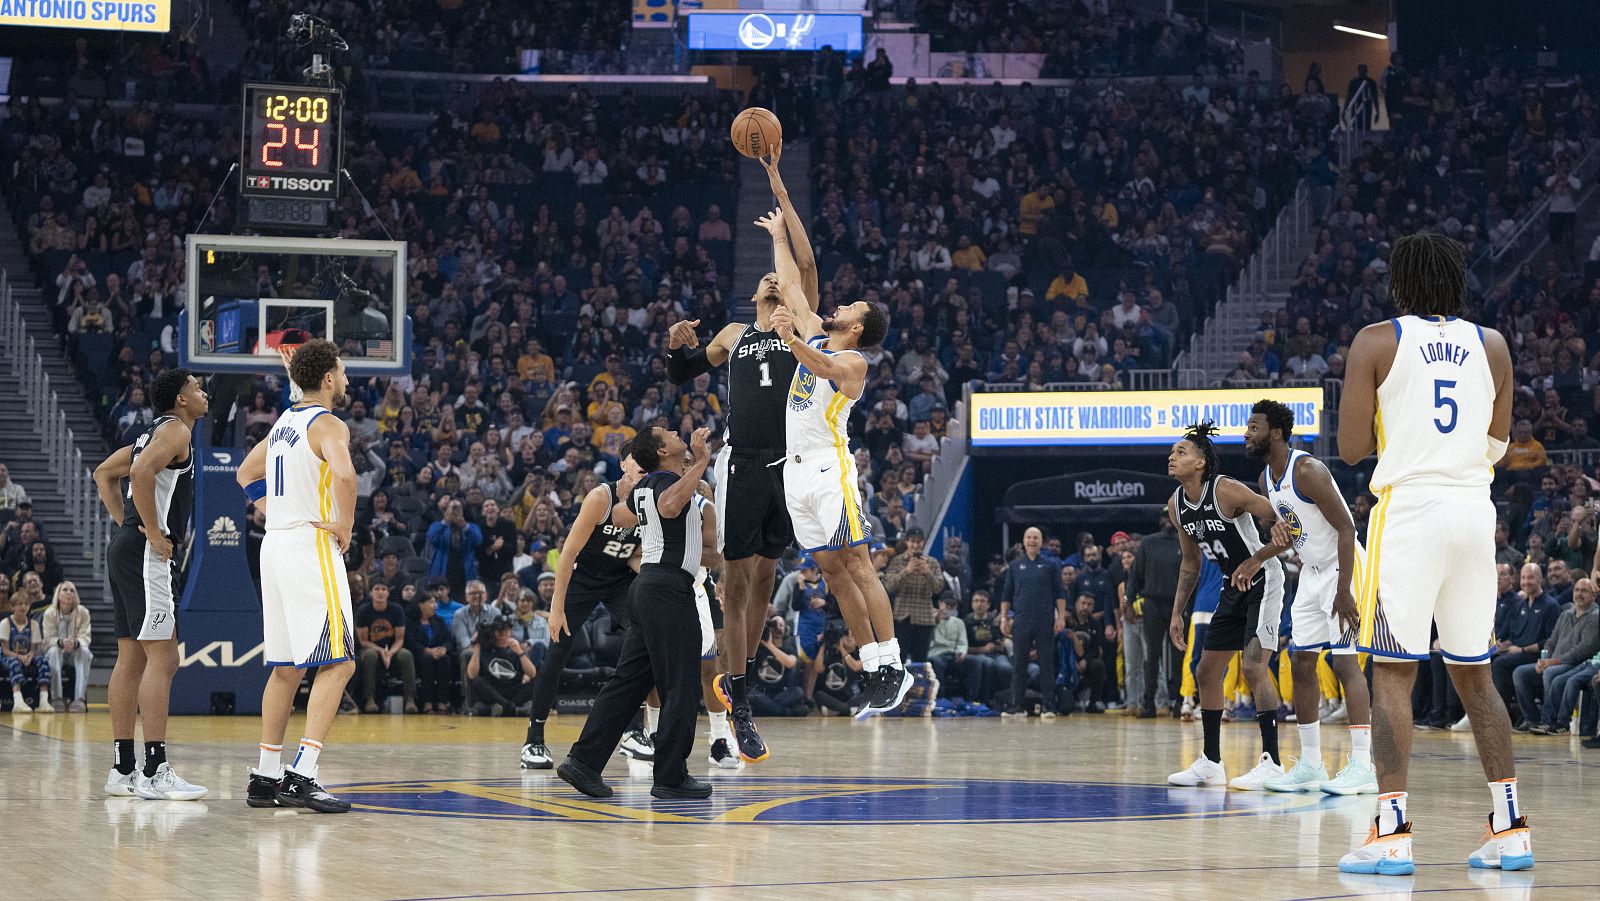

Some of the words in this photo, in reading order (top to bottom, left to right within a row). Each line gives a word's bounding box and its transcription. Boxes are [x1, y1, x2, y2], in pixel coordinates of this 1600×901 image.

[0, 0, 86, 20] ANTONIO
[91, 2, 157, 24] SPURS
[265, 95, 329, 123] 12:00
[261, 122, 320, 167] 24
[270, 176, 333, 192] TISSOT
[738, 338, 792, 360] SPURS
[1419, 341, 1470, 367] LOONEY
[758, 361, 773, 387] 1
[801, 372, 815, 387] 30
[979, 406, 1032, 430] GOLDEN
[1034, 406, 1074, 430] STATE
[1078, 405, 1152, 430] WARRIORS
[1171, 404, 1199, 428] SAN
[1203, 403, 1252, 427] ANTON
[1433, 378, 1459, 434] 5
[274, 454, 284, 497] 11
[1074, 480, 1145, 499] Rakuten
[637, 495, 648, 526] 5
[1182, 519, 1226, 540] SPURS
[602, 541, 636, 559] 23
[1198, 539, 1229, 560] 24
